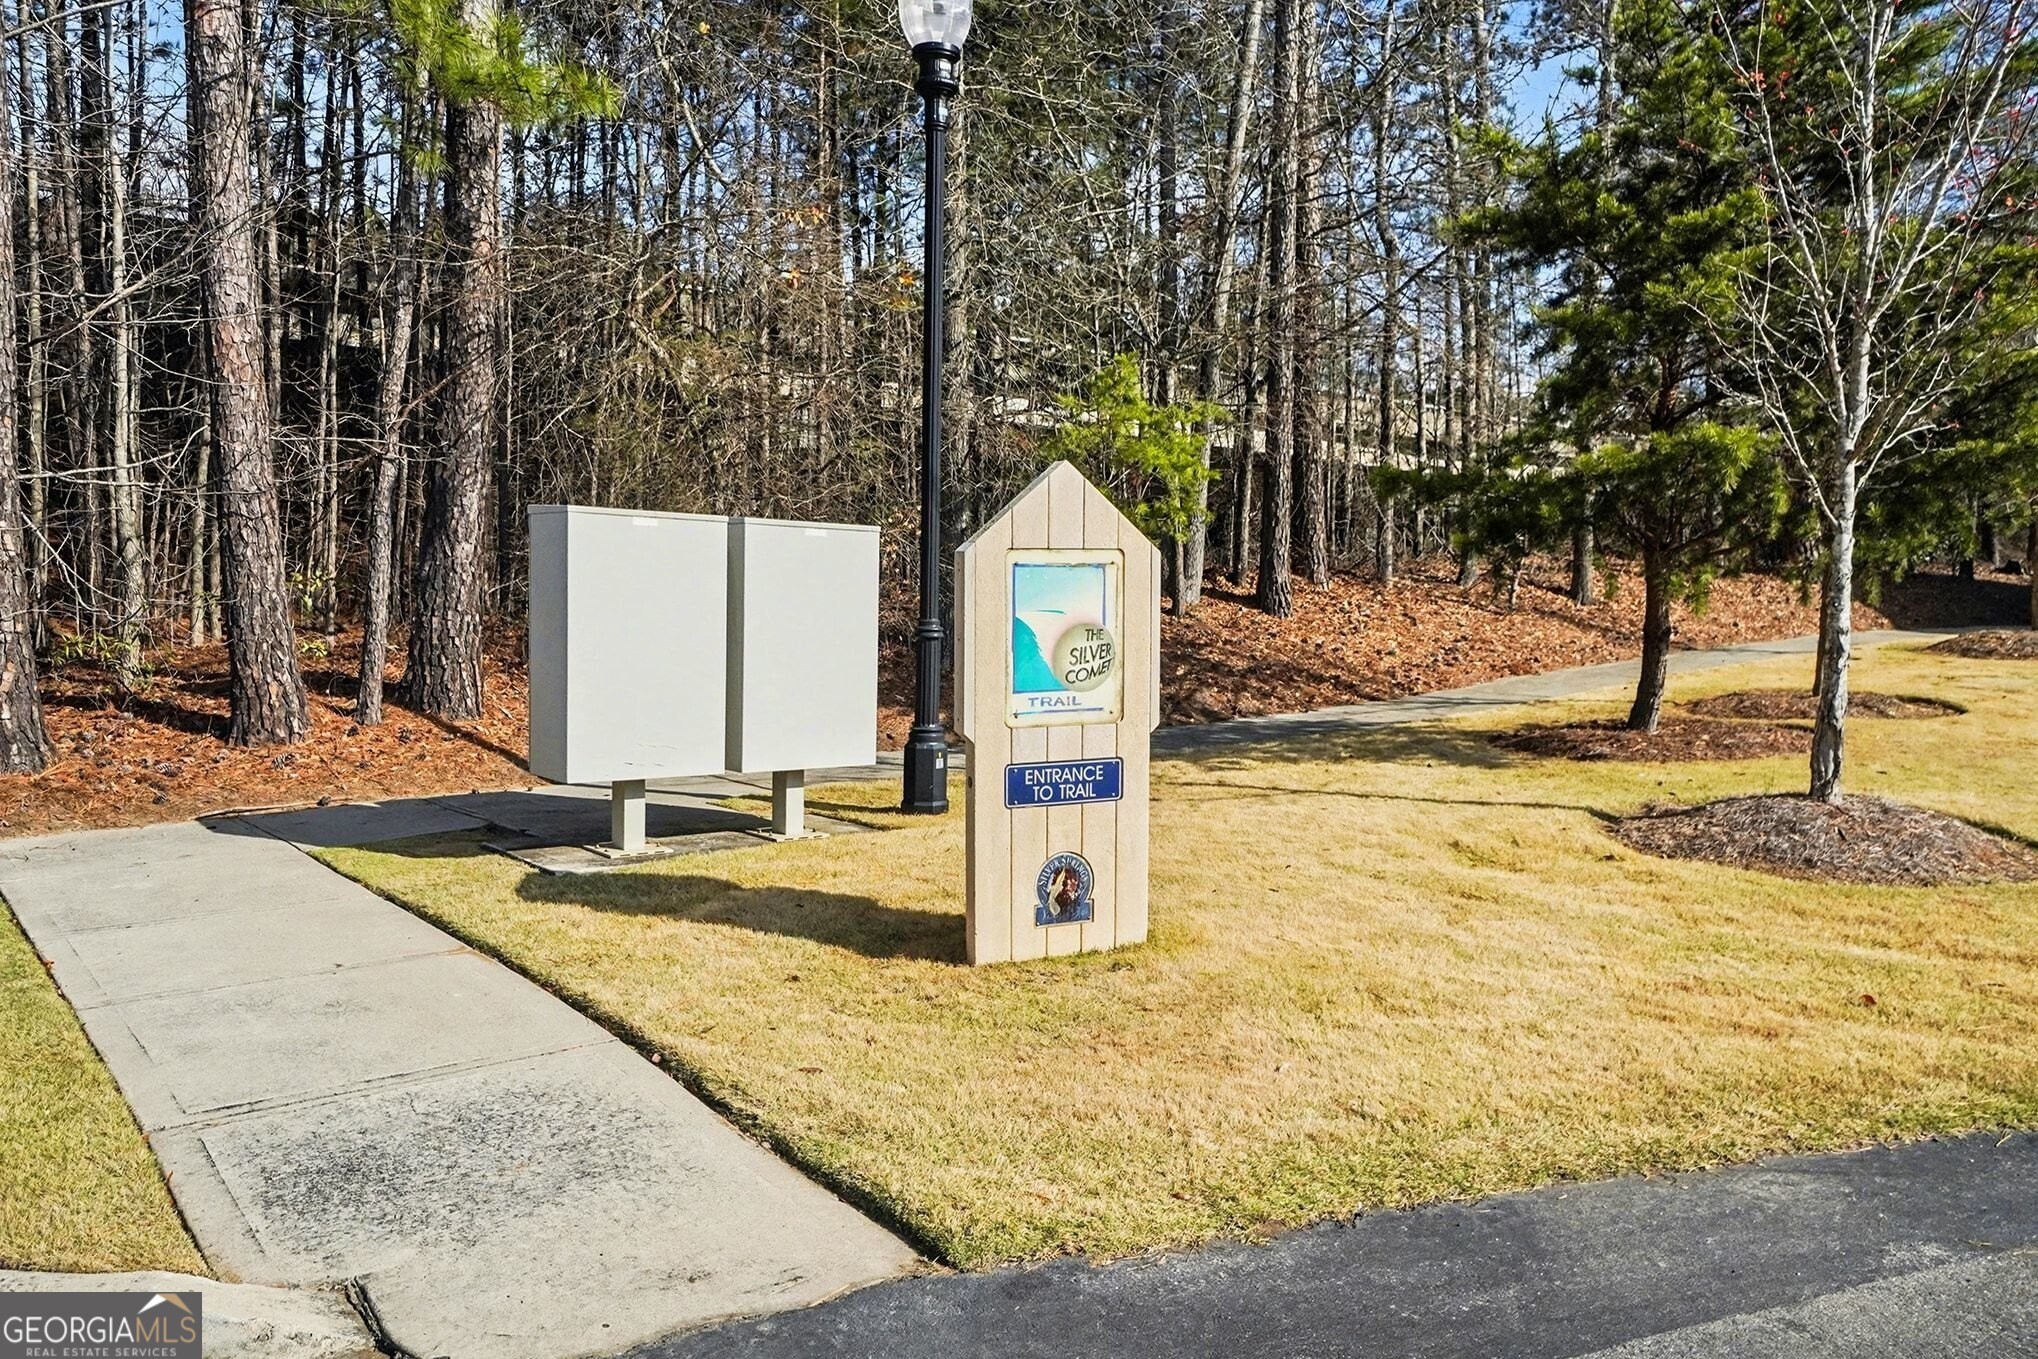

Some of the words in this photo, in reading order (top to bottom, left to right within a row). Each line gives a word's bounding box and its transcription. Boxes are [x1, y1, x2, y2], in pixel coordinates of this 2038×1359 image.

[1085, 628, 1104, 642] THE
[1069, 643, 1112, 666] SILVER
[1065, 658, 1112, 684] COMET
[1028, 696, 1082, 707] TRAIL
[1025, 765, 1104, 785] ENTRANCE
[1033, 785, 1053, 801] TO
[1059, 783, 1096, 799] TRAIL
